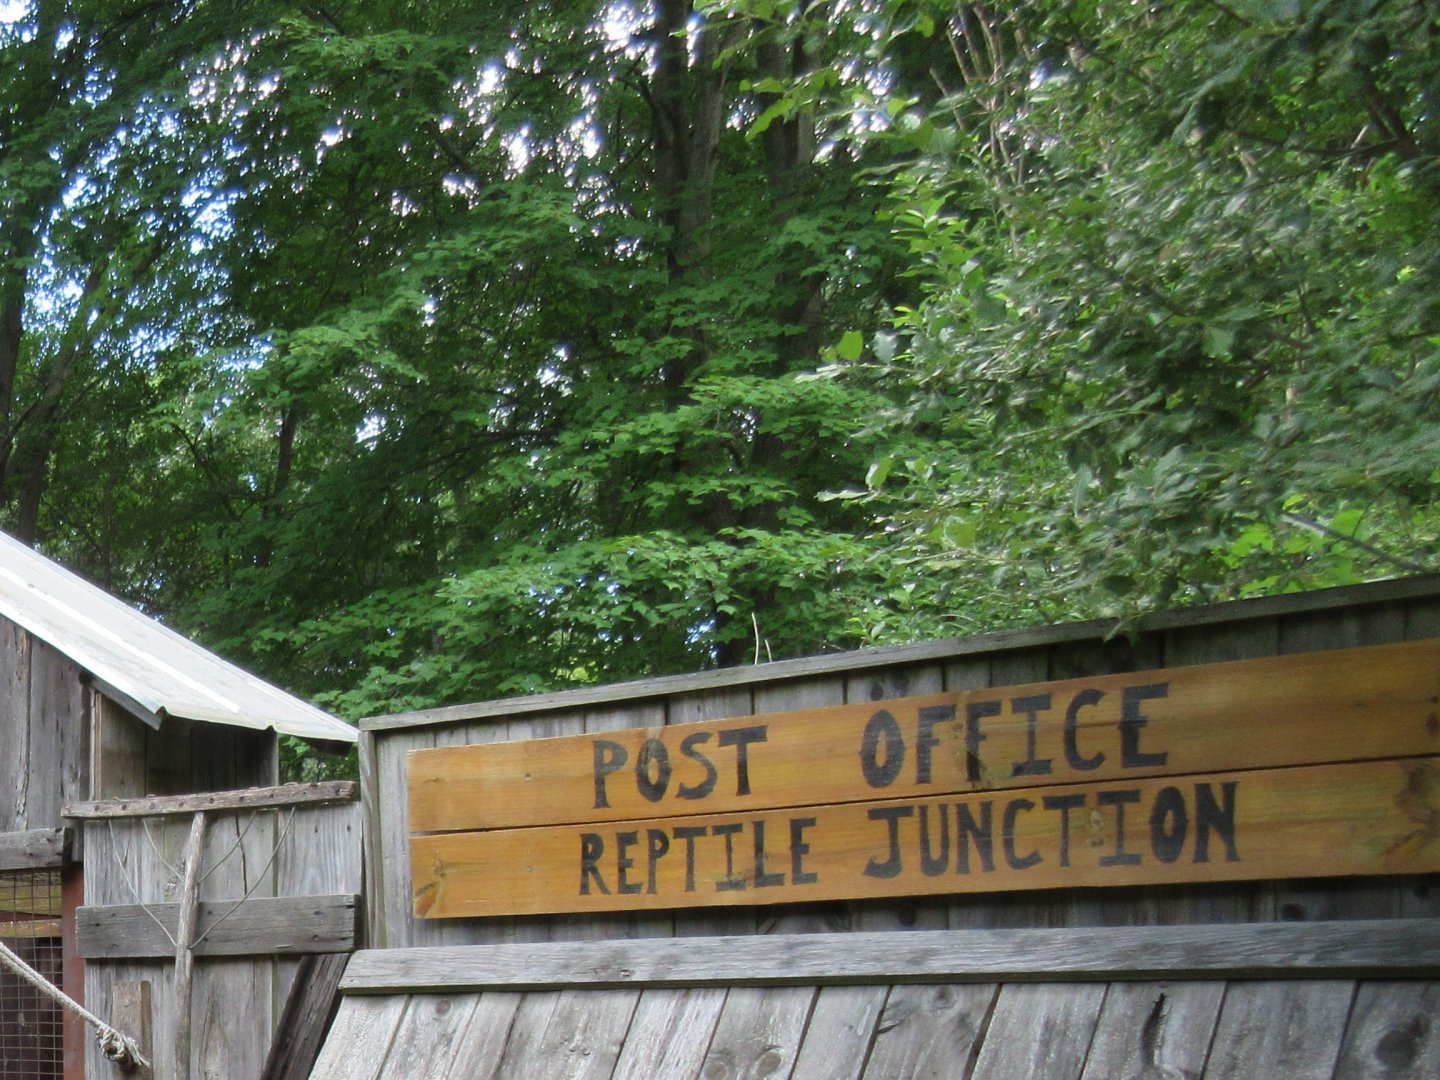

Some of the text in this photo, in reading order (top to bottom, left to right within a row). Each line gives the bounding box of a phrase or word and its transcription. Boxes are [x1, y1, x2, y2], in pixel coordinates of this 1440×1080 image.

[592, 682, 1170, 809] POST OFFICE
[579, 781, 1242, 897] REPTILE JUNCTION
